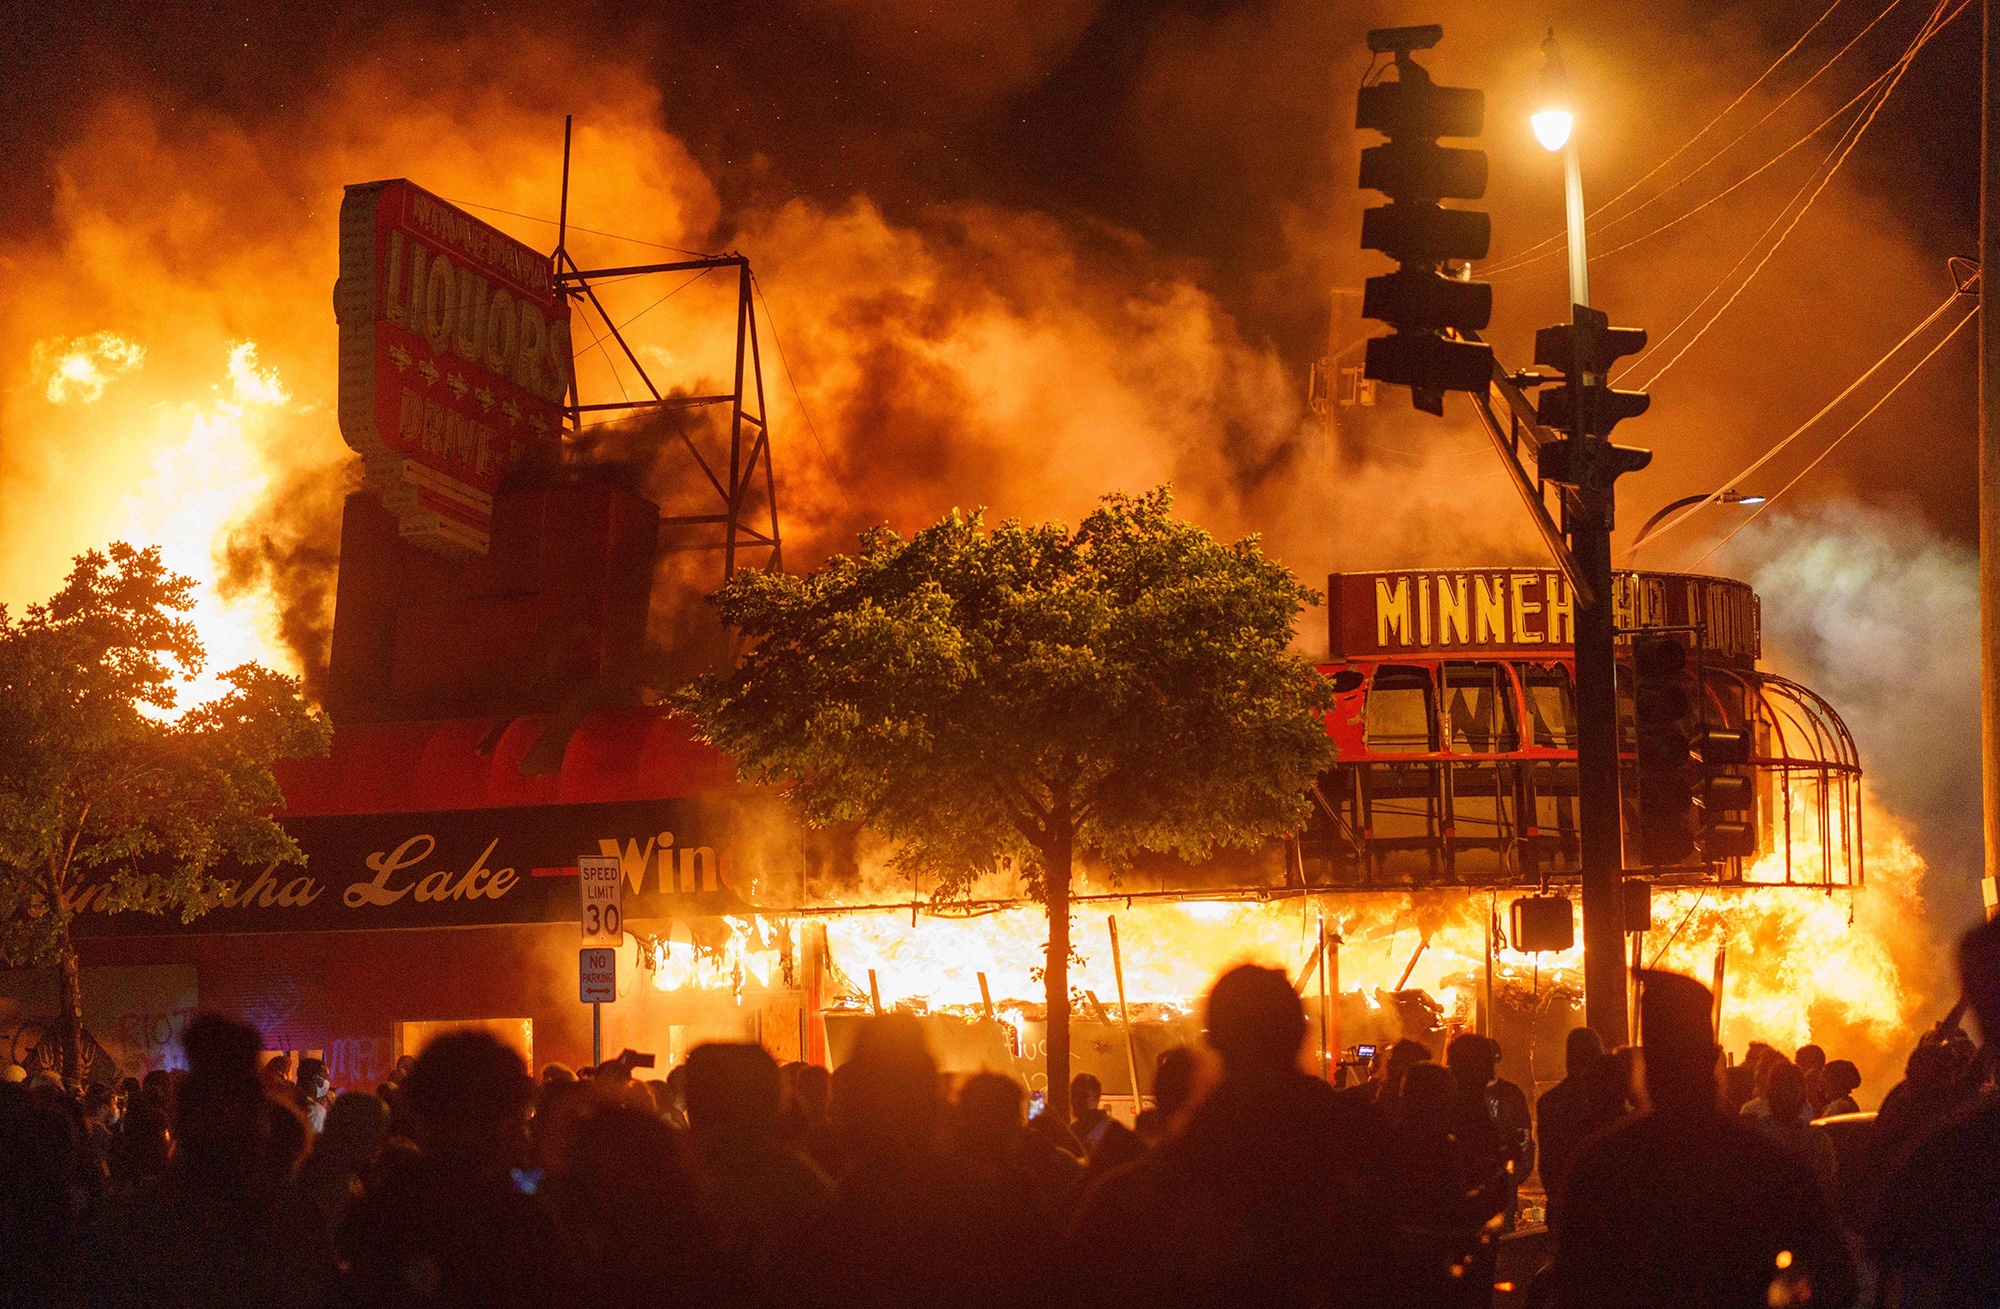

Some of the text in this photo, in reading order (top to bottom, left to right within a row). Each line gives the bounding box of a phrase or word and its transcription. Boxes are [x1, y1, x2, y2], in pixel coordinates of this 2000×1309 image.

[386, 229, 569, 403] LIQUORS
[343, 834, 520, 908] Lake
[583, 867, 617, 881] SPEED
[588, 886, 614, 899] LIMIT
[586, 904, 619, 936] 30
[589, 955, 606, 969] NO
[582, 972, 613, 983] PARKING
